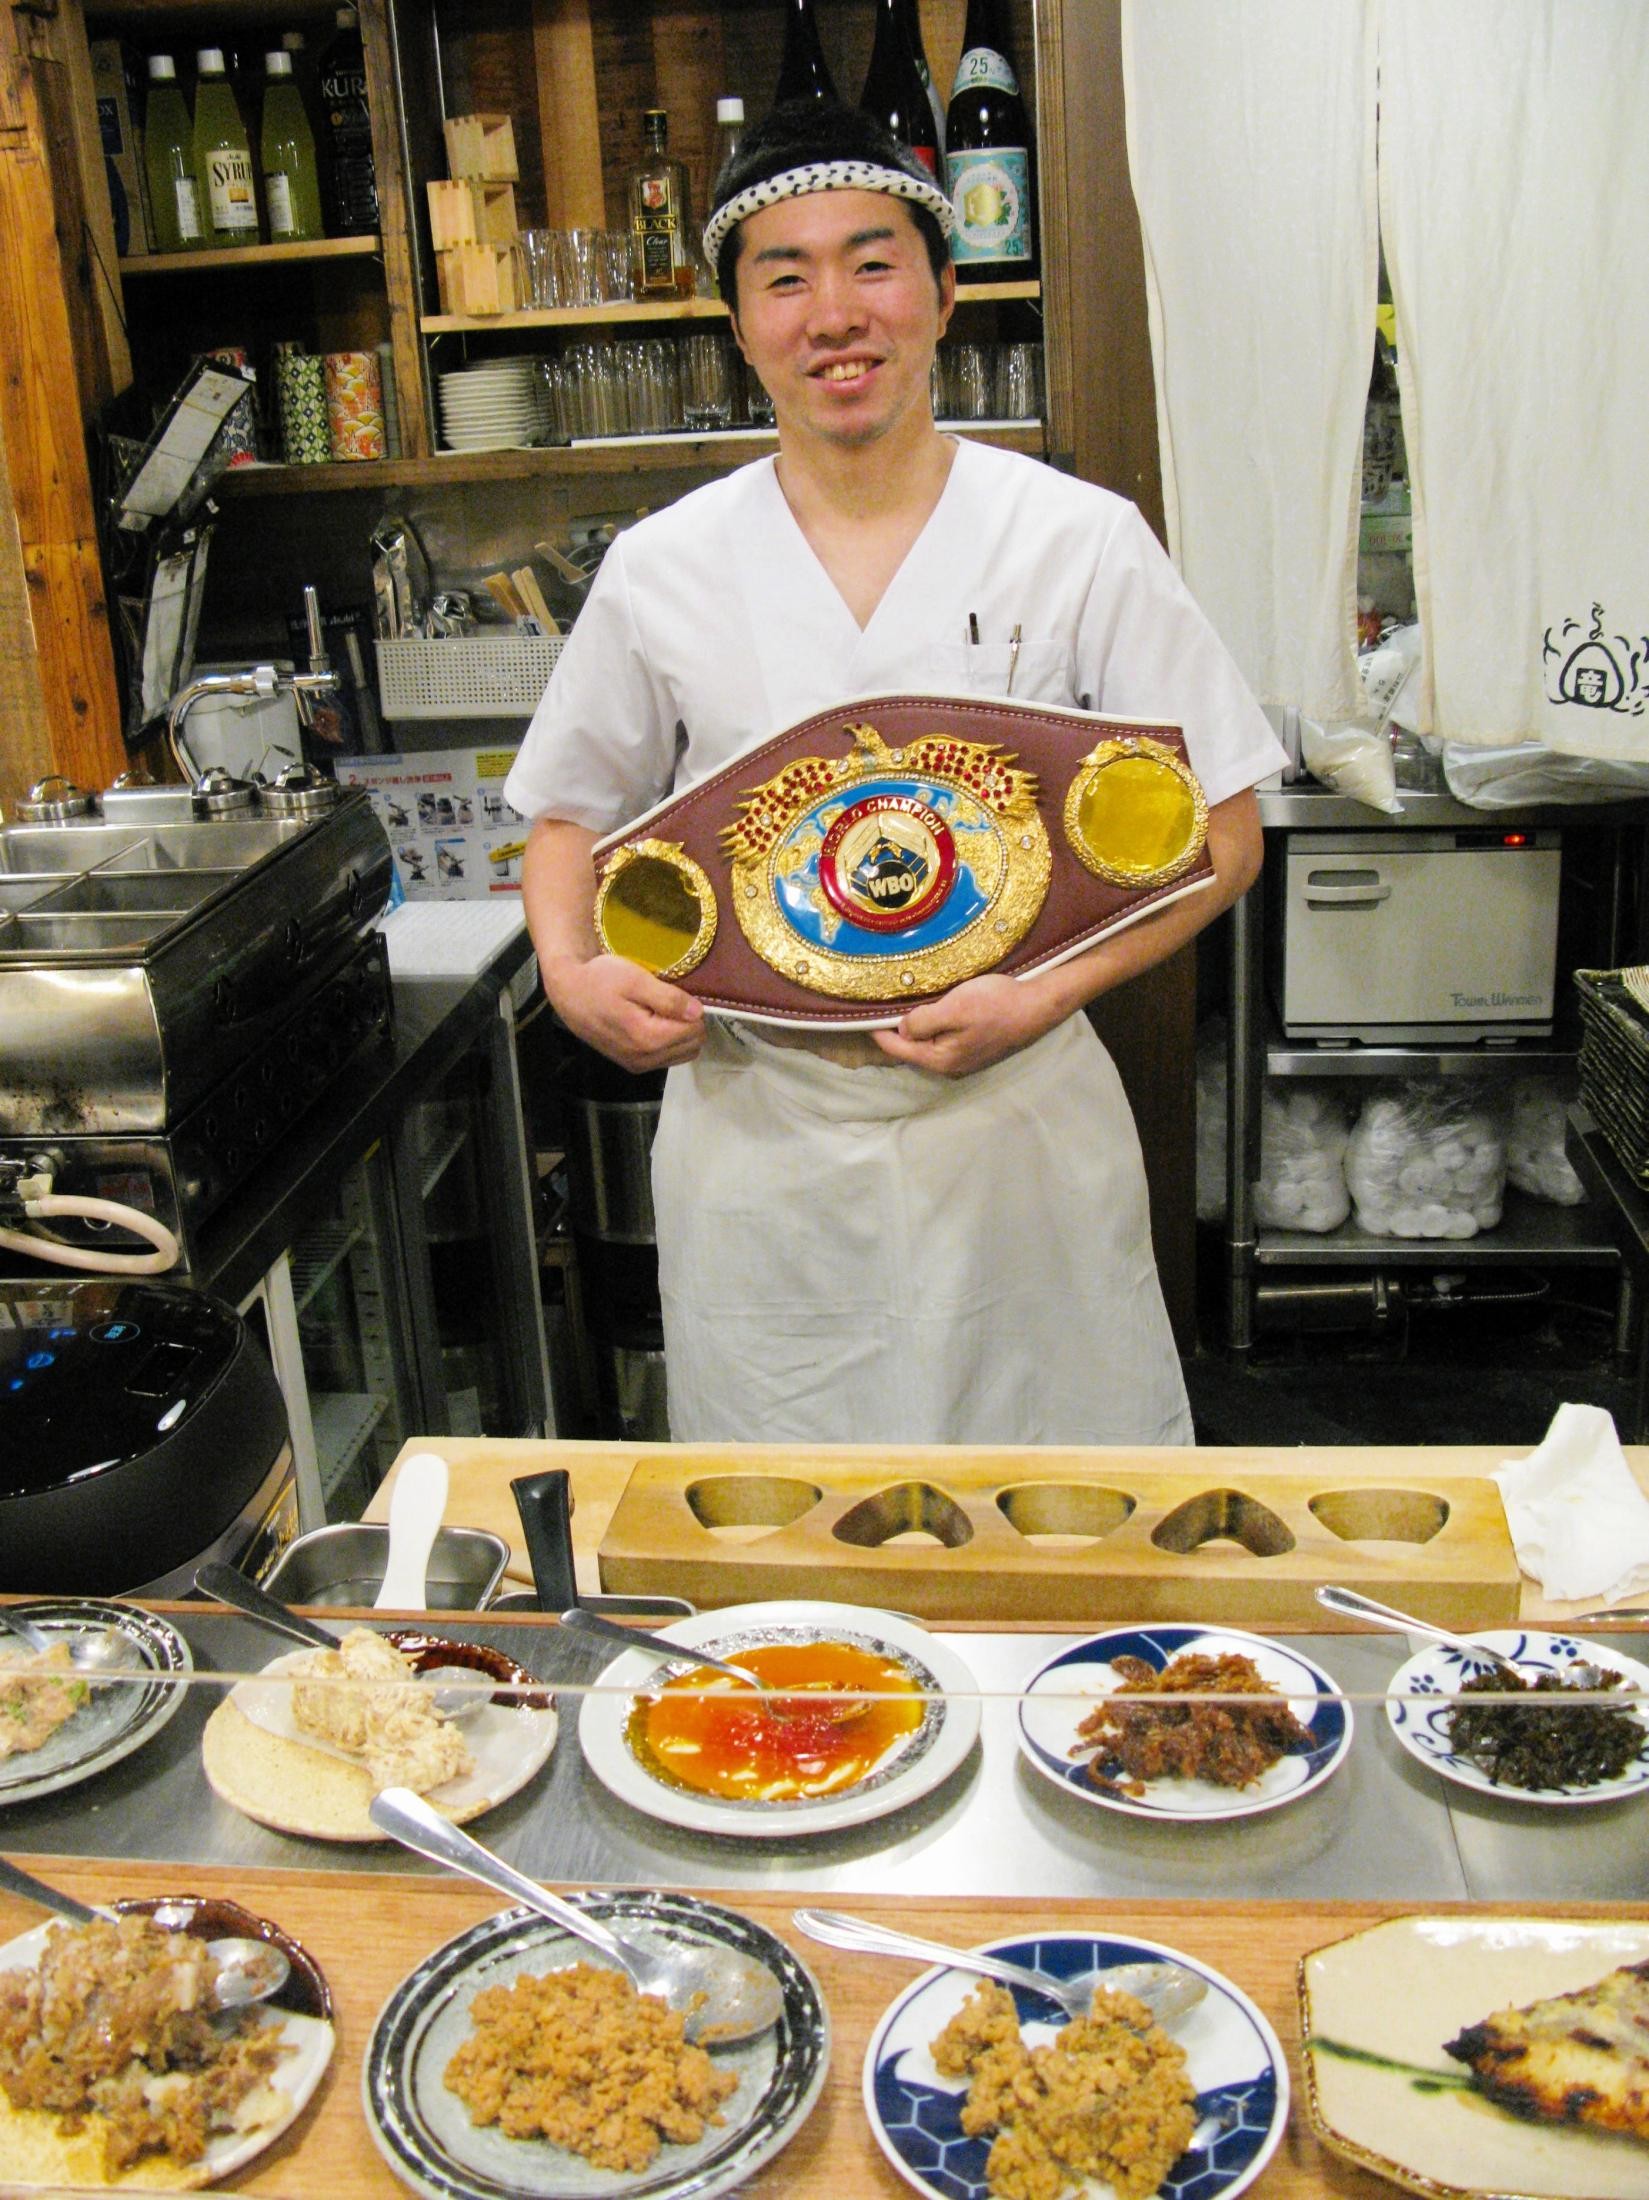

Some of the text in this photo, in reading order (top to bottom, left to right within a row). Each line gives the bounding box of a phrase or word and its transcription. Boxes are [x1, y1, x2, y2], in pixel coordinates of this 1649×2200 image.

[635, 217, 677, 231] BLACK
[822, 796, 946, 857] WORLD CHAMPION
[868, 872, 914, 898] WBO
